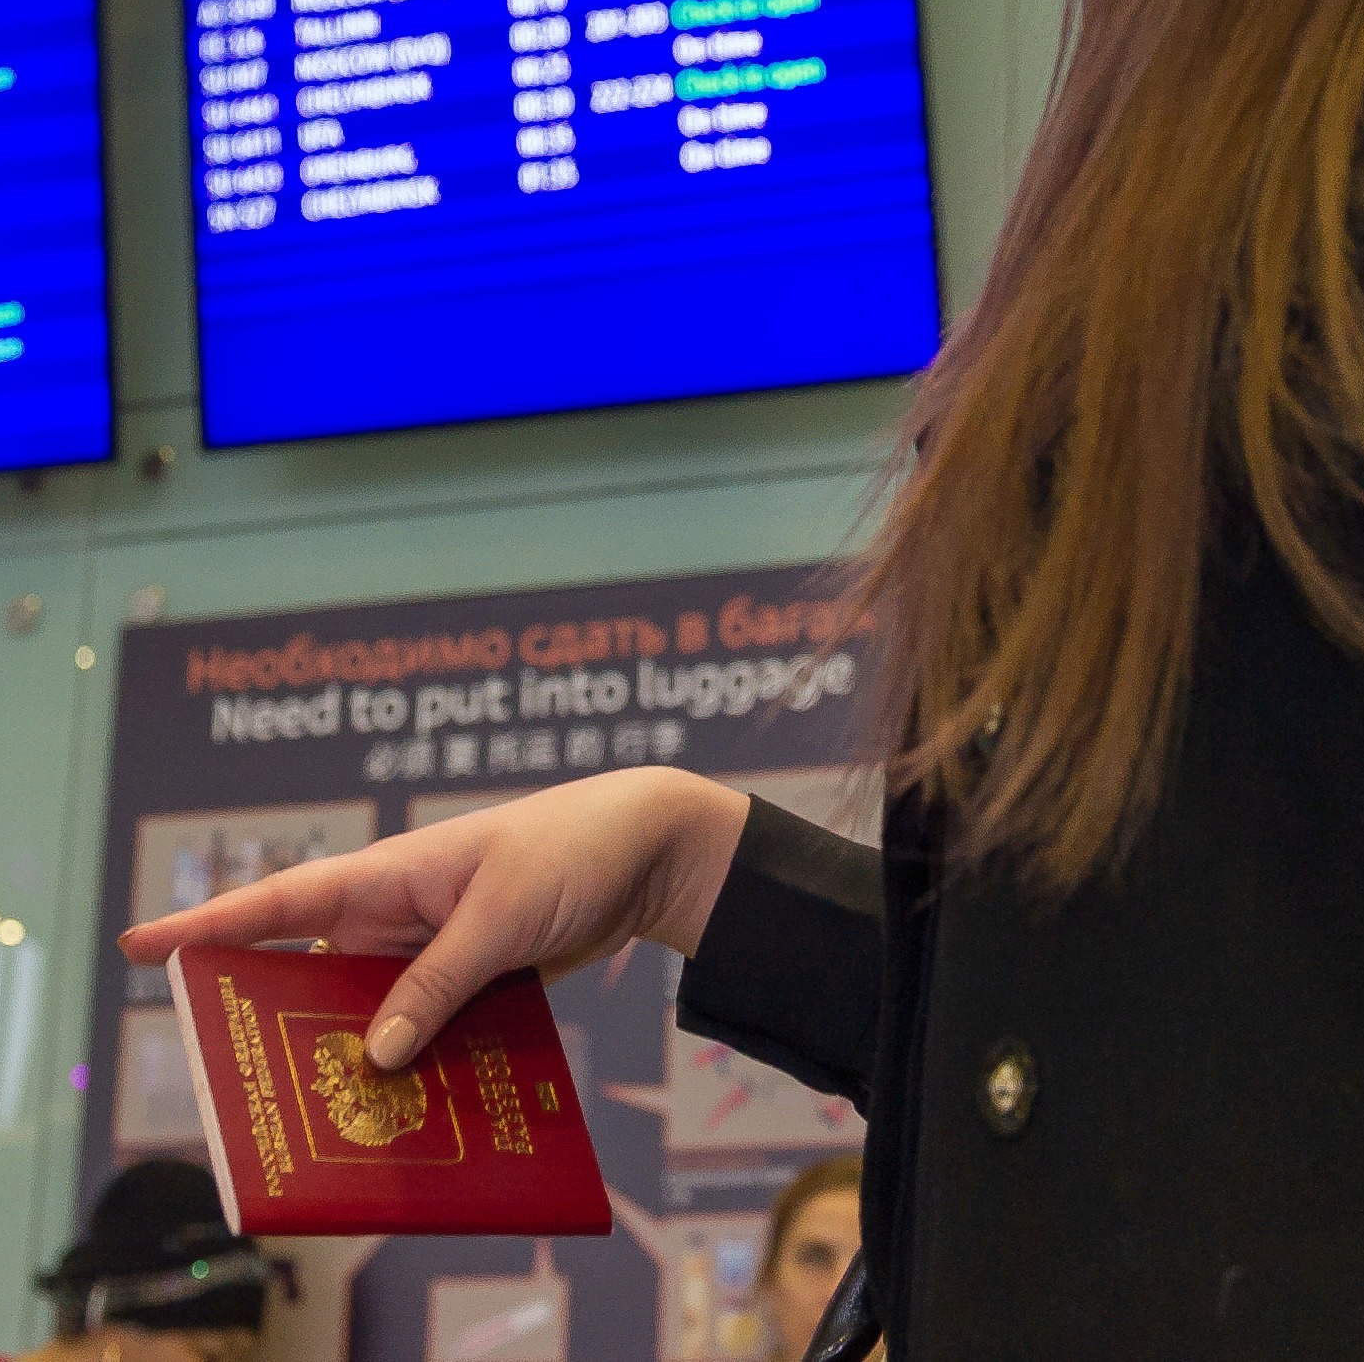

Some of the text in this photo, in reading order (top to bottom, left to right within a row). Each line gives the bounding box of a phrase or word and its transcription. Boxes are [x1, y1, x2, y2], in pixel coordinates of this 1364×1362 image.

[186, 627, 513, 696] Необходимо
[518, 615, 669, 669] сдать
[675, 609, 709, 655] в
[211, 651, 857, 745] Need to put into luggage
